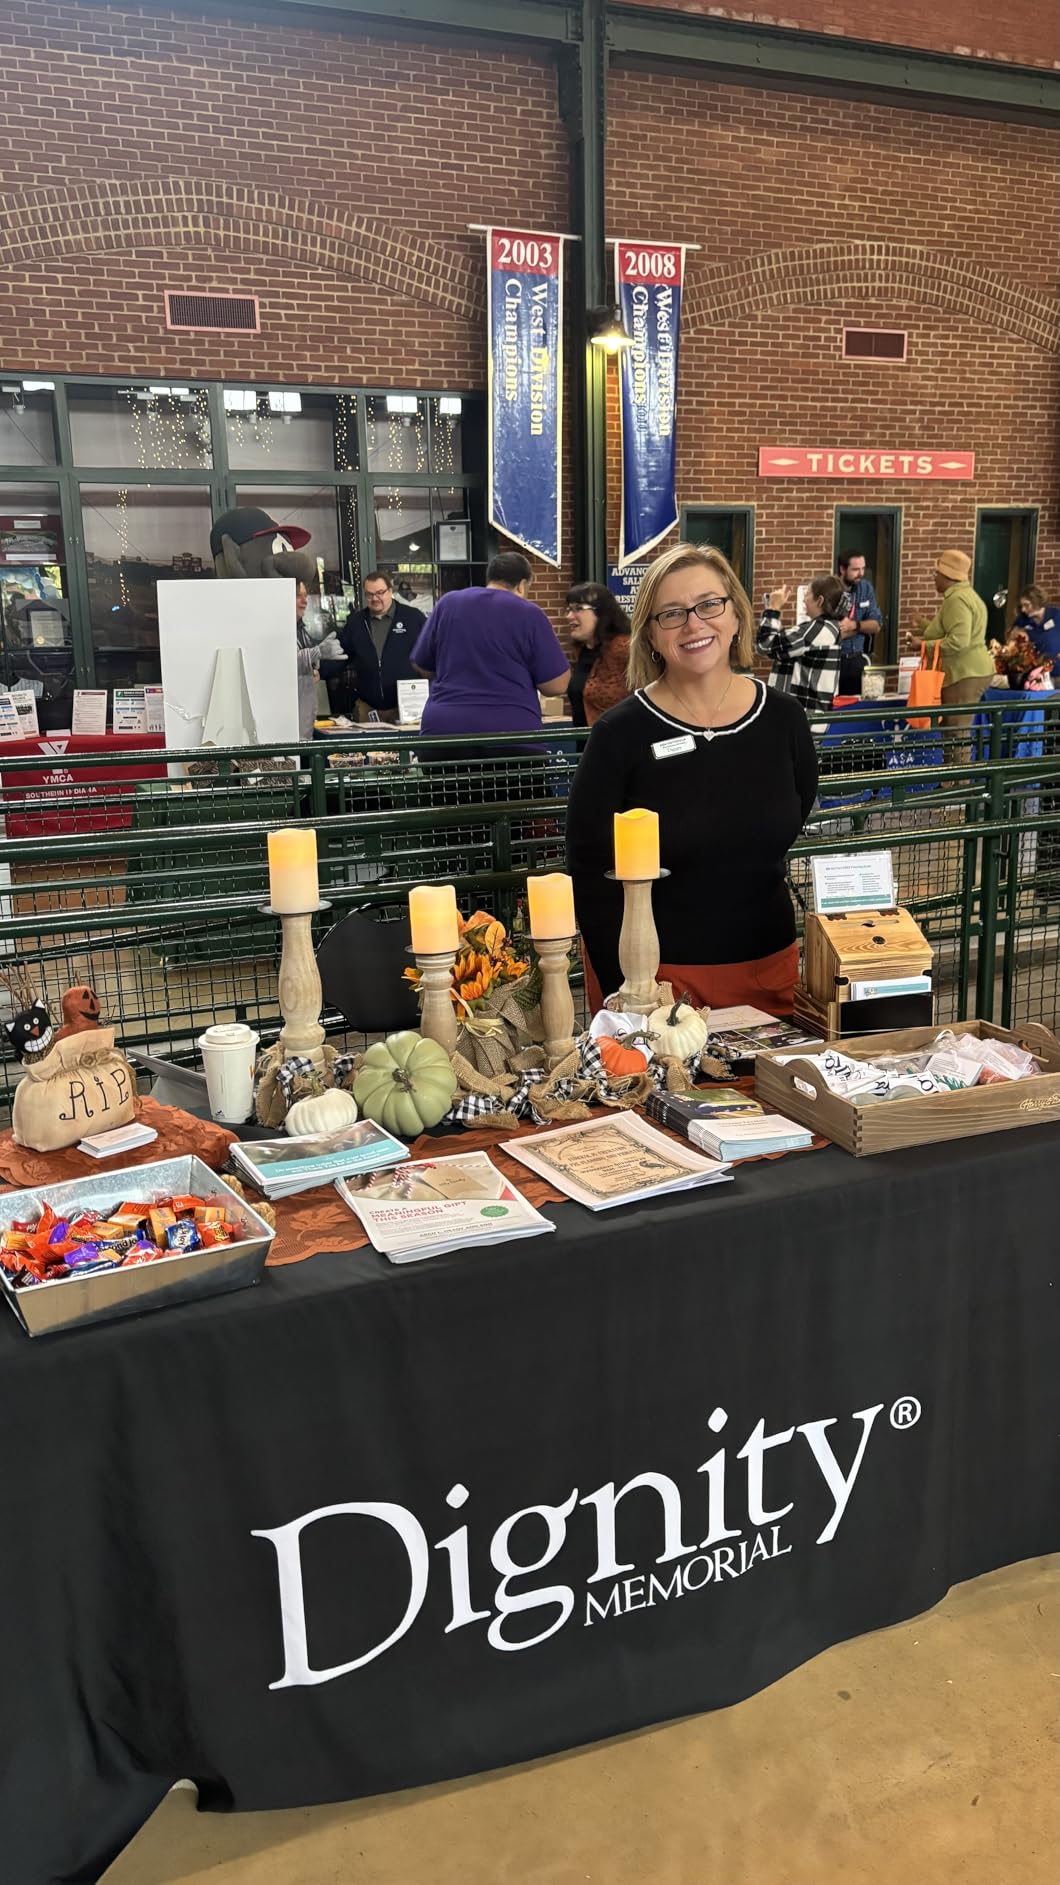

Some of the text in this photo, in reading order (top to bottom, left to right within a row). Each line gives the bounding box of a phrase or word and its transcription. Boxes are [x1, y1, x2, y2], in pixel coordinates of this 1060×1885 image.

[498, 238, 553, 269] 2003
[624, 250, 676, 278] 2008
[504, 277, 523, 402] Champions
[632, 285, 649, 405] Champions
[530, 282, 548, 436] West Division
[806, 453, 934, 474] TICKETS
[611, 567, 648, 577] ADVANC
[615, 595, 637, 603] REST
[43, 774, 74, 784] YMCA
[370, 1200, 467, 1219] MEANINGFUL GIFT
[400, 1208, 444, 1219] SEASON
[583, 1525, 793, 1627] MEMORIAL
